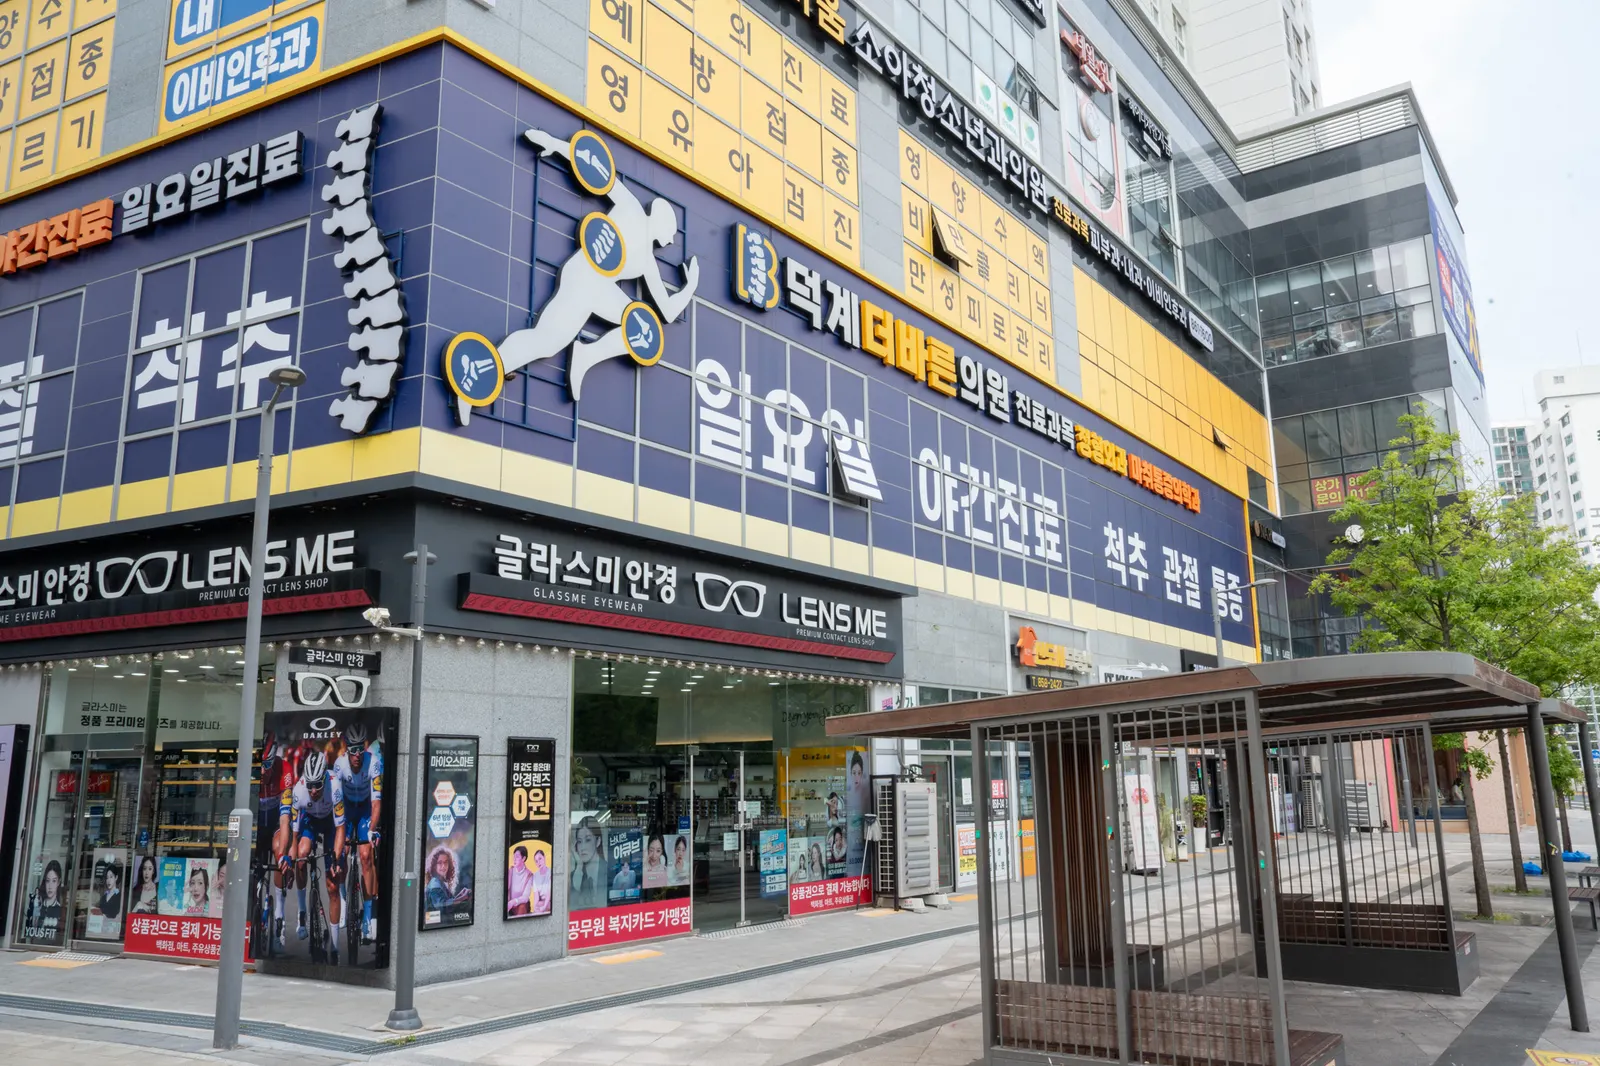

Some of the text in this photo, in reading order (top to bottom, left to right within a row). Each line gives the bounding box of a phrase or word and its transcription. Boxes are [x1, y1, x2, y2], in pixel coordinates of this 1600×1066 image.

[172, 22, 311, 116] 이비인후과
[855, 20, 1048, 211] 소아청소년과의원
[121, 129, 304, 235] 일요일진료
[1053, 196, 1090, 246] 진료과목
[134, 290, 293, 424] 척추
[1016, 390, 1075, 450] 진료과목
[695, 358, 1244, 623] 일요일 야간진료 척추 관절 통증
[494, 533, 678, 605] 글라스미안경
[199, 577, 329, 602] PREMIUM COACT LENS SHOP
[533, 587, 644, 613] GLASSME EYEWEAR
[15, 609, 57, 623] EYEWEAR
[796, 628, 822, 639] PREMIUM
[823, 632, 846, 642] CONTACT
[861, 637, 875, 647] SHOP
[306, 649, 365, 668] 글라스미 안경
[81, 701, 128, 713] 글라스미는
[80, 715, 102, 727] 정품
[105, 716, 146, 728] 프리미엄
[180, 719, 223, 731] 제공합니다.
[303, 731, 342, 740] OAKLEY
[430, 755, 475, 768] 마이오스마트
[512, 773, 551, 787] 안경렌즈
[512, 788, 551, 821] 0원
[613, 838, 641, 860] 아큐브
[792, 884, 825, 901] 상품권으로
[826, 881, 839, 896] 결제
[131, 918, 178, 936] 상품권으로
[181, 920, 201, 938] 결제
[568, 904, 691, 941] 공무원 복지카드 가맹점
[155, 939, 175, 953] 백화점,
[177, 940, 190, 953] 마트,
